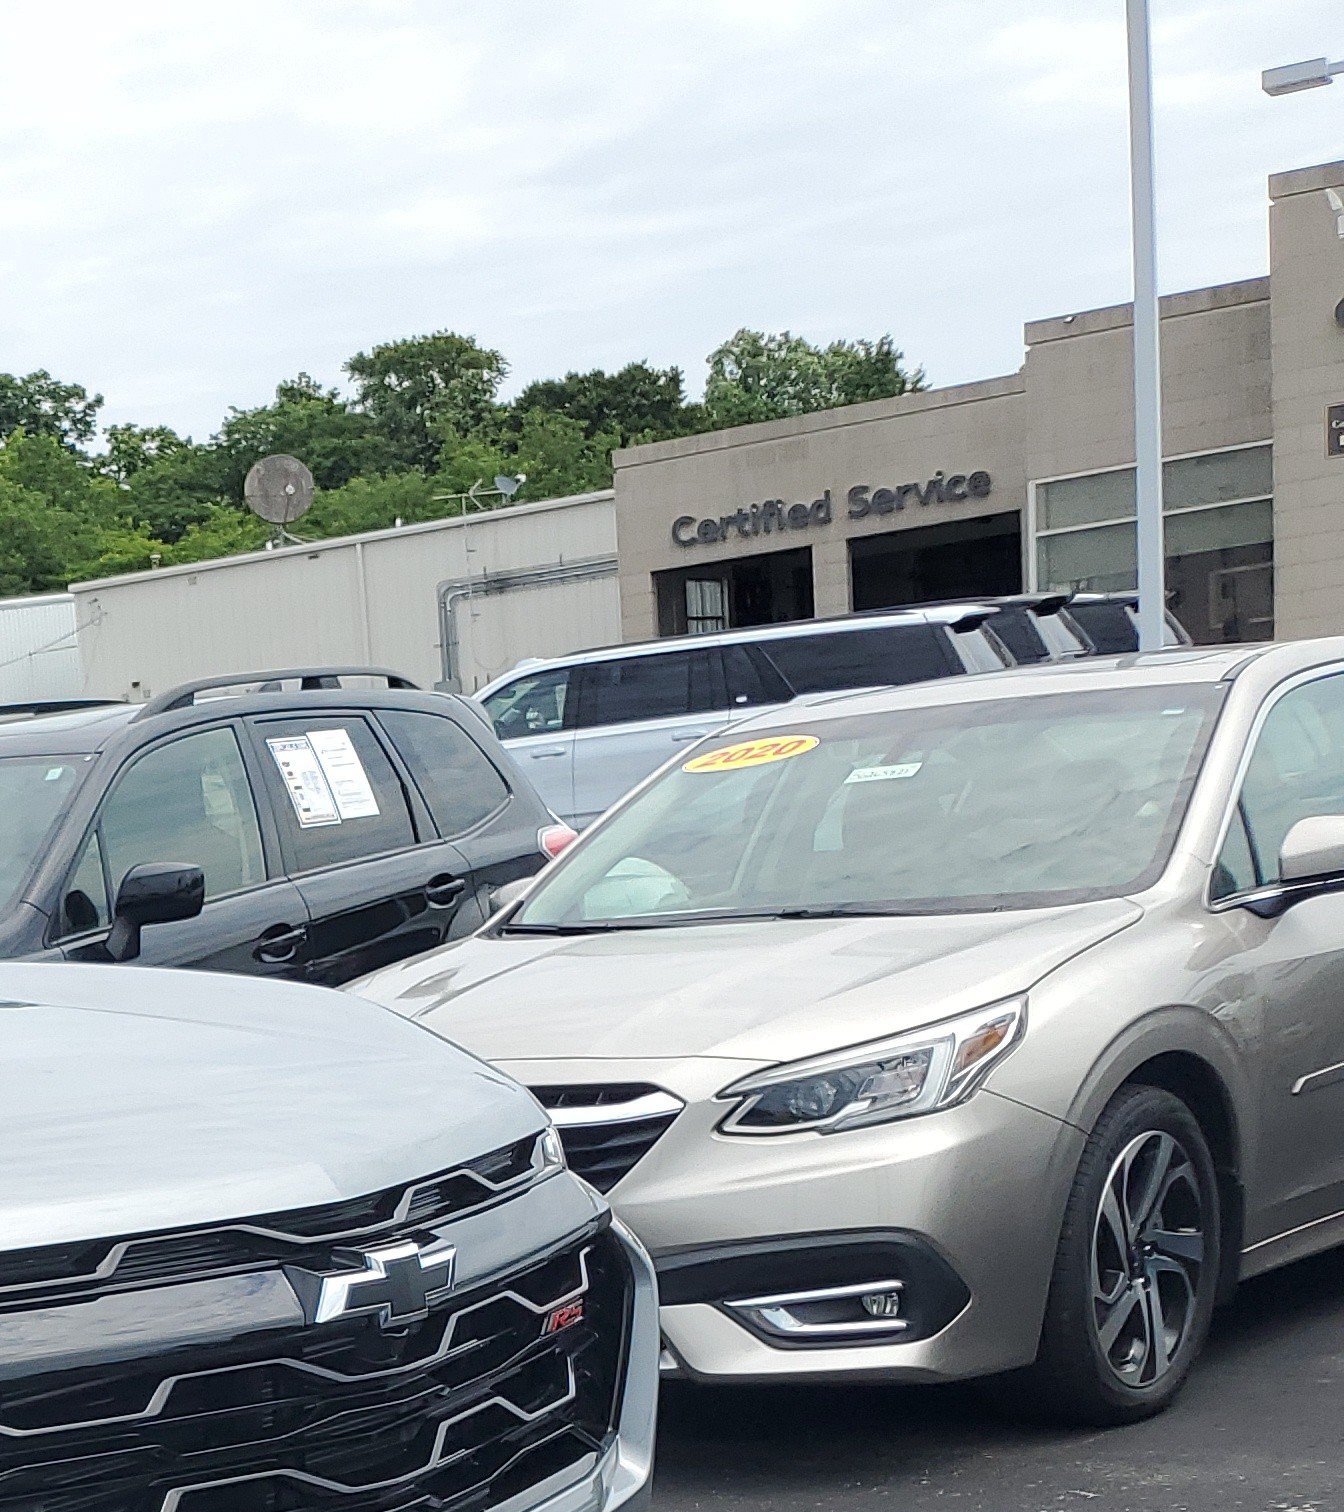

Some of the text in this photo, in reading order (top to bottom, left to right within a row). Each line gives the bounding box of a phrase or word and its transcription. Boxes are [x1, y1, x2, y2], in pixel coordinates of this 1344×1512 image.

[671, 470, 992, 547] Certified Service
[693, 739, 807, 769] 2020
[546, 1298, 584, 1333] RS
